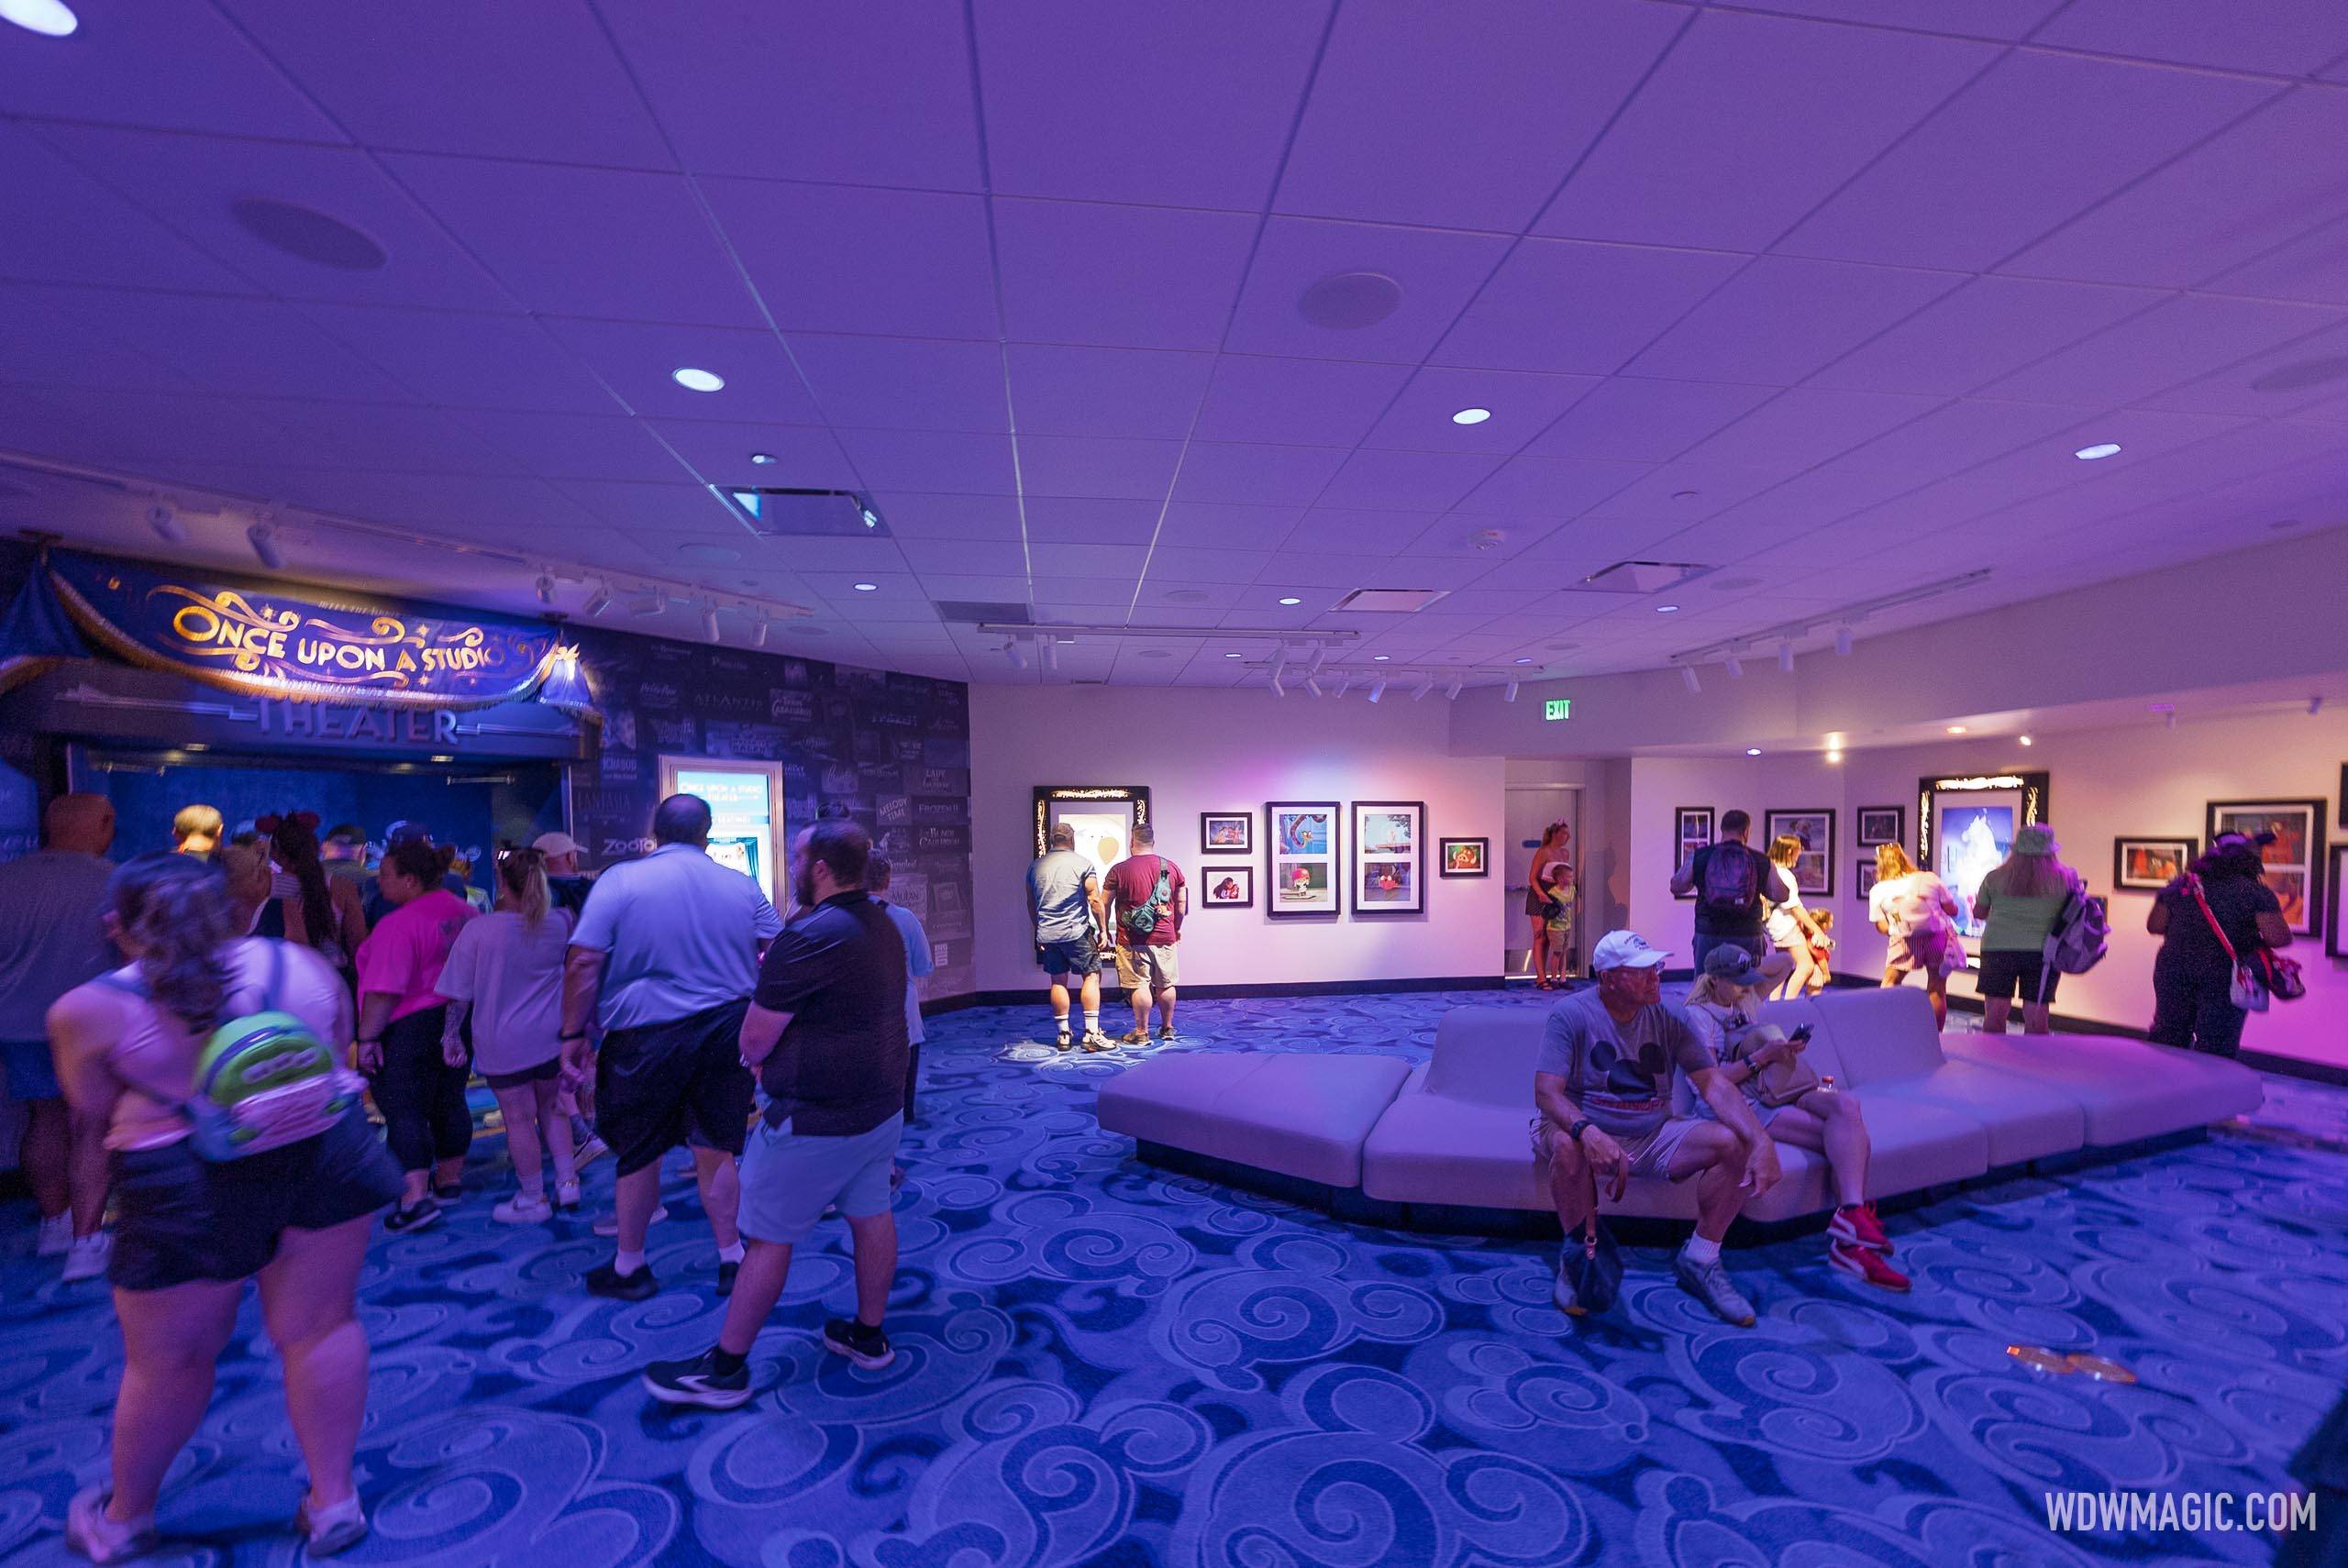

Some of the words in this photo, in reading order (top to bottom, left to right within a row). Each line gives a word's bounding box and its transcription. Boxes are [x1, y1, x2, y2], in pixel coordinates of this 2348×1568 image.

[173, 605, 288, 659] ONCE
[297, 637, 386, 672] UPON
[395, 649, 417, 672] A
[421, 646, 505, 672] STUDIO
[249, 697, 459, 745] THEATER
[1545, 700, 1571, 720] EXIT
[879, 797, 910, 816] MELODY
